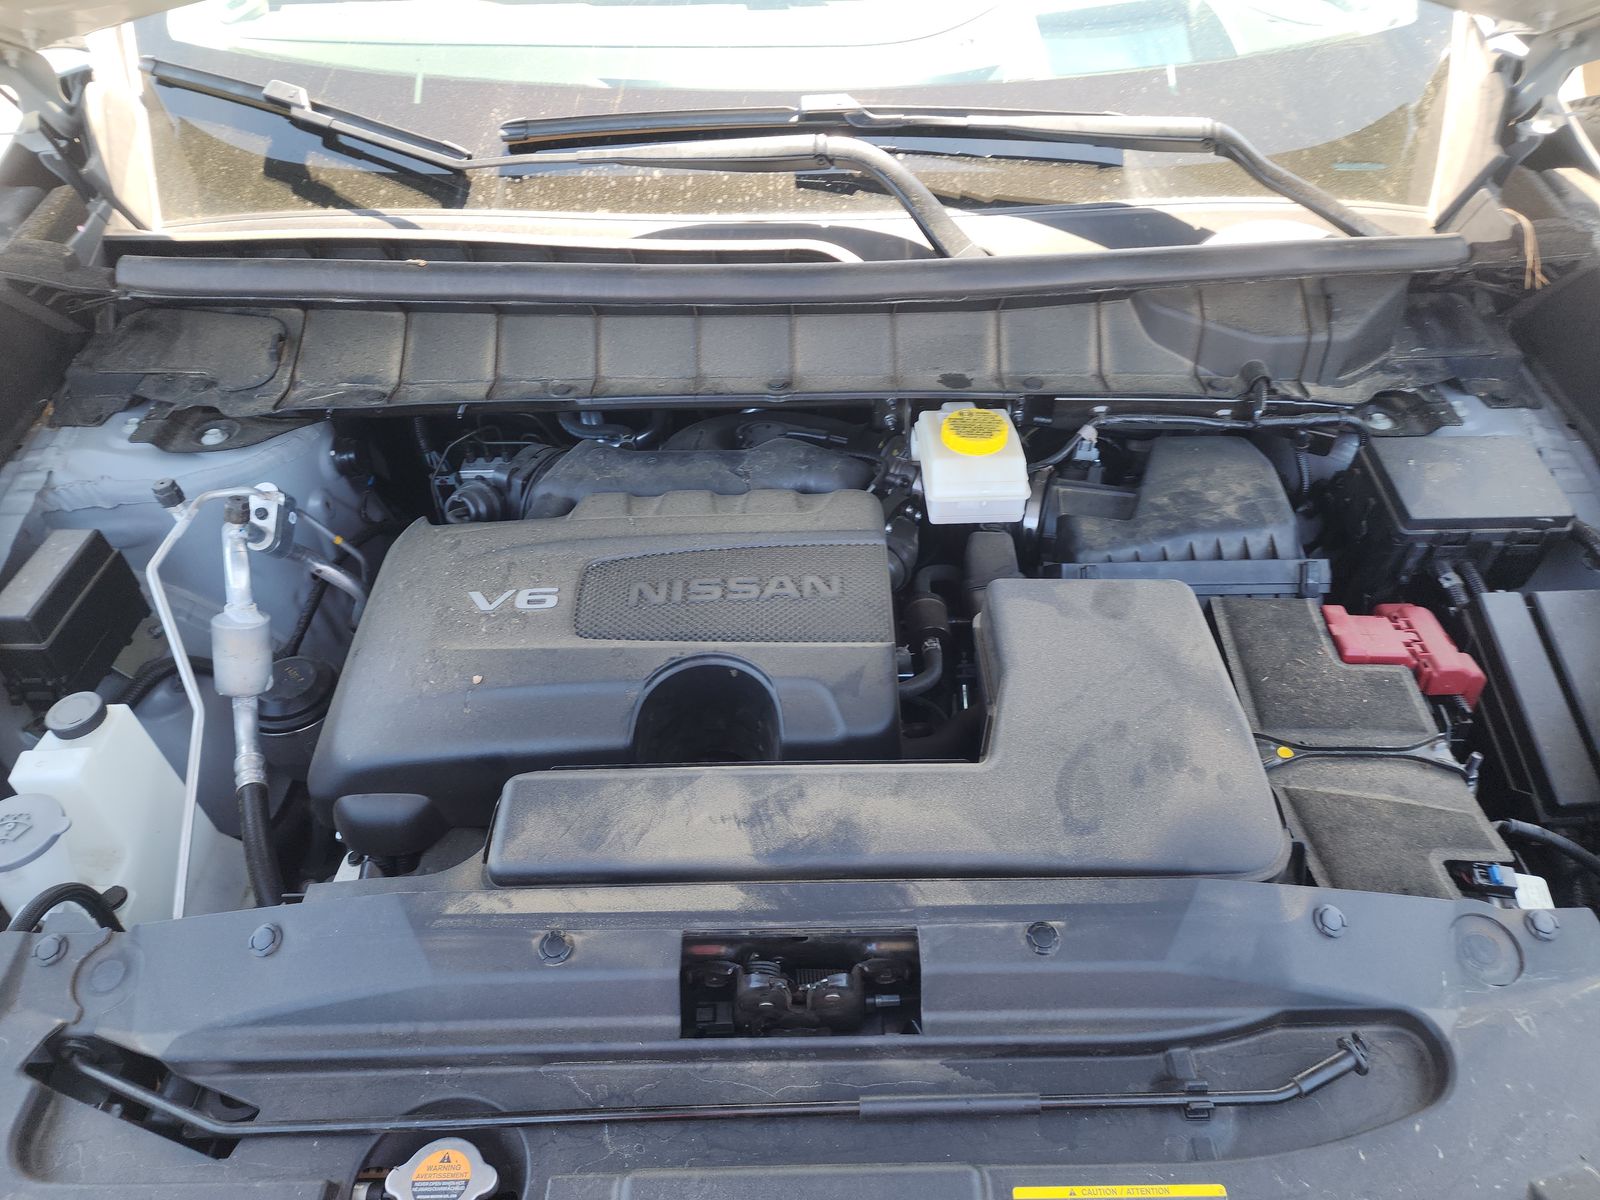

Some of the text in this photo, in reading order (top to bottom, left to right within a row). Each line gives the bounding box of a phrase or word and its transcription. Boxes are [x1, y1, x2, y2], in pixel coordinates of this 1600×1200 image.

[468, 587, 560, 612] V6
[626, 574, 843, 606] NISSAN
[1081, 1188, 1118, 1196] CAUTION
[1126, 1187, 1170, 1196] ATTENTION
